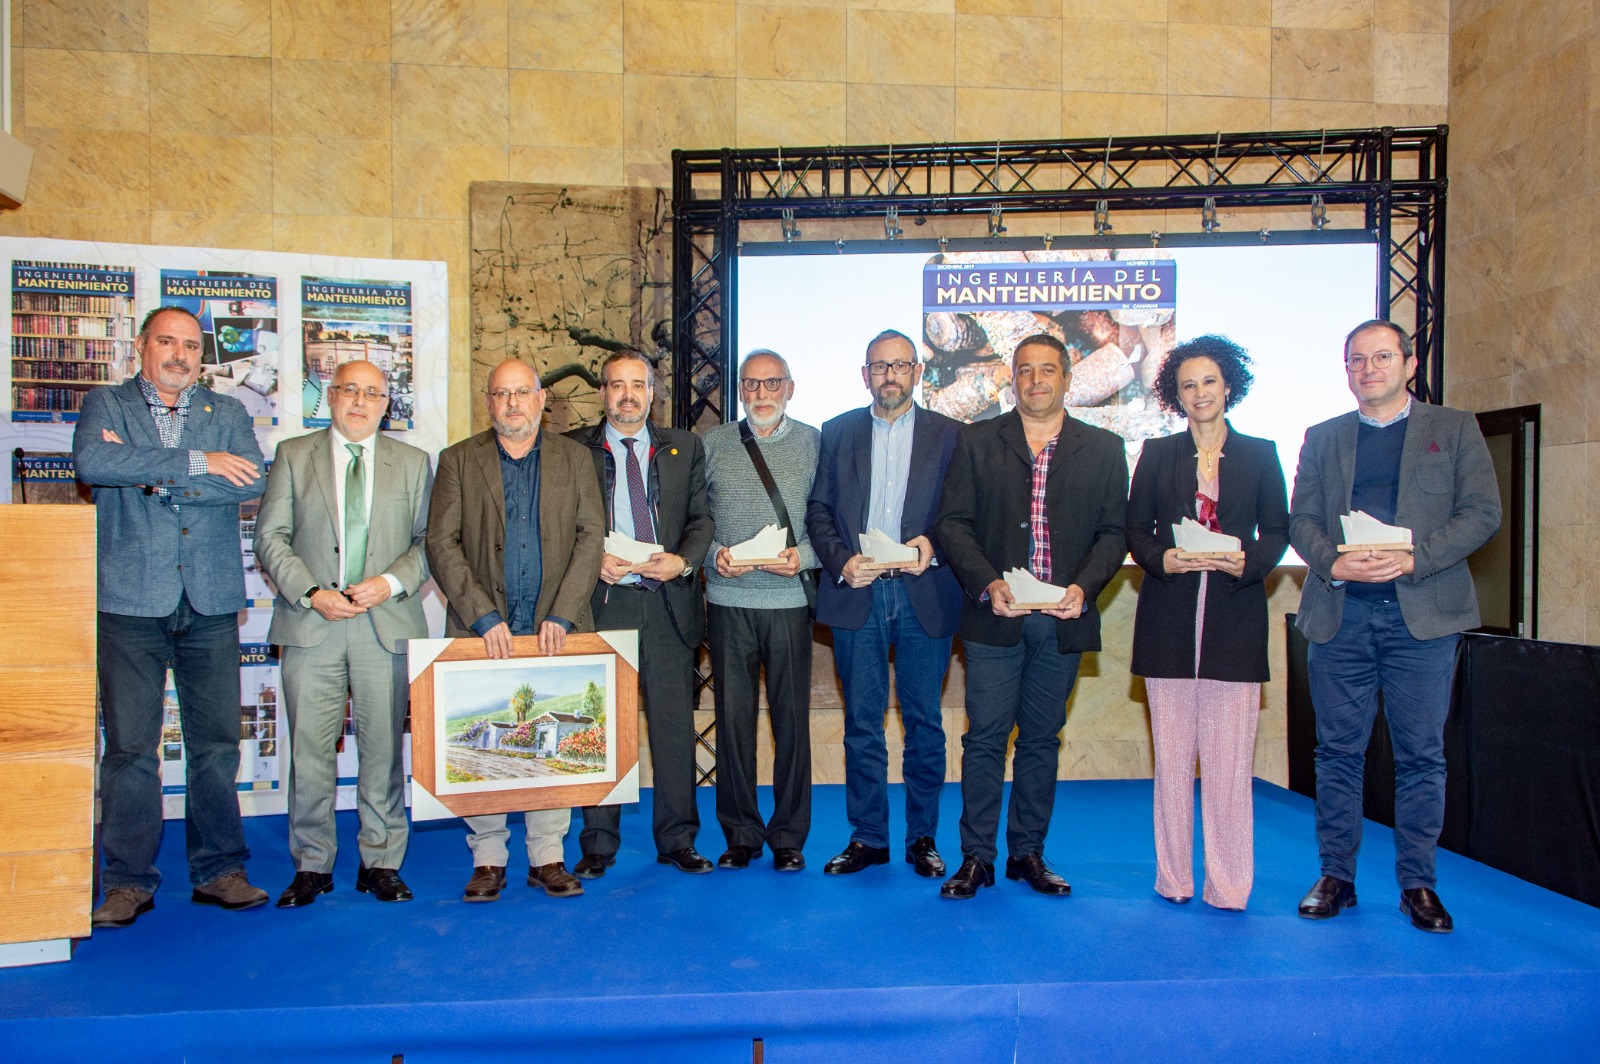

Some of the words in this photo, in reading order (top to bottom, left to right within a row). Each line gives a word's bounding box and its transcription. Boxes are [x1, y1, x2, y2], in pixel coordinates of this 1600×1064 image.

[18, 270, 98, 281] INGENIERÍA
[105, 275, 129, 284] DEL
[937, 268, 1096, 286] INGENIERÍA
[1115, 269, 1161, 283] DEL
[18, 278, 129, 292] MANTENIMIENTO
[166, 279, 242, 288] INGENIERÍA
[249, 281, 271, 290] DEL
[307, 285, 379, 296] INGENIERÍA
[385, 289, 406, 297] DEL
[167, 285, 272, 299] MANTENIMIENTO
[307, 292, 407, 306] MANTENIMIENTO
[937, 283, 1162, 304] MANTENIMIENTO
